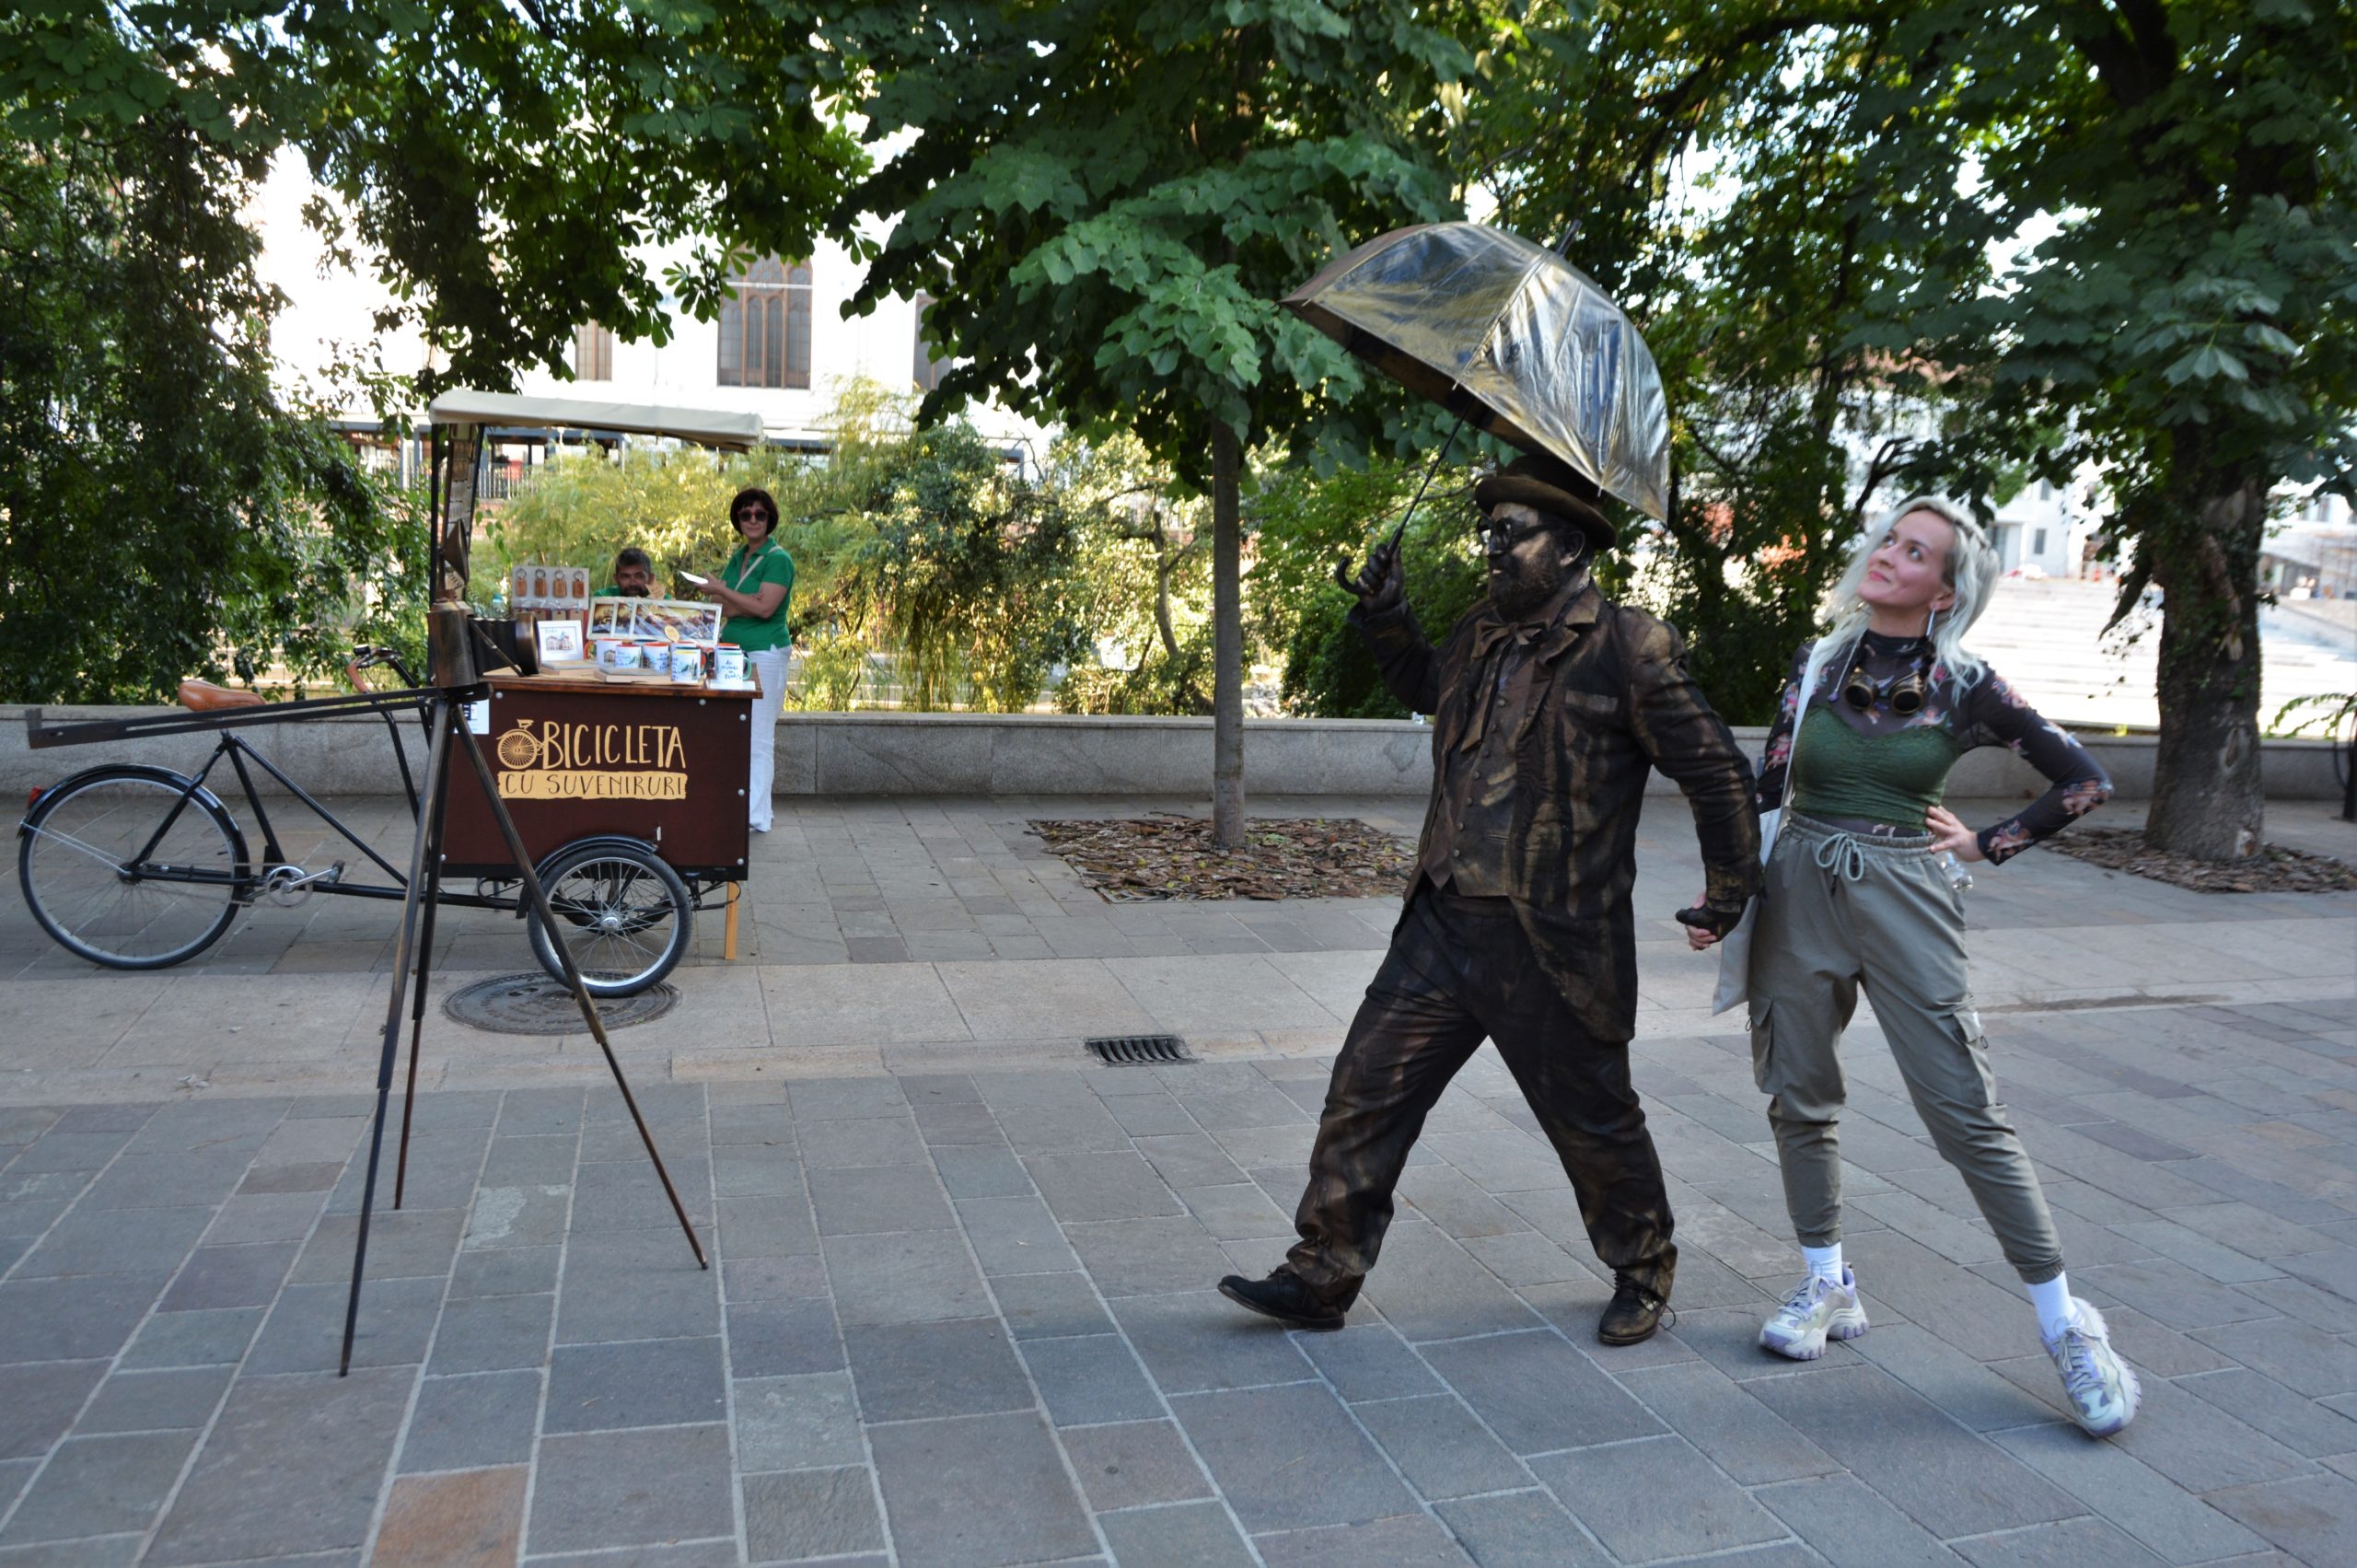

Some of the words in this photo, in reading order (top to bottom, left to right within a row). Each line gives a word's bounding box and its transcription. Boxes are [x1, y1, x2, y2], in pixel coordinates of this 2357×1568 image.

[542, 721, 686, 770] BICICLETA
[505, 773, 534, 795] CU
[545, 773, 681, 796] SUVENIRURI
